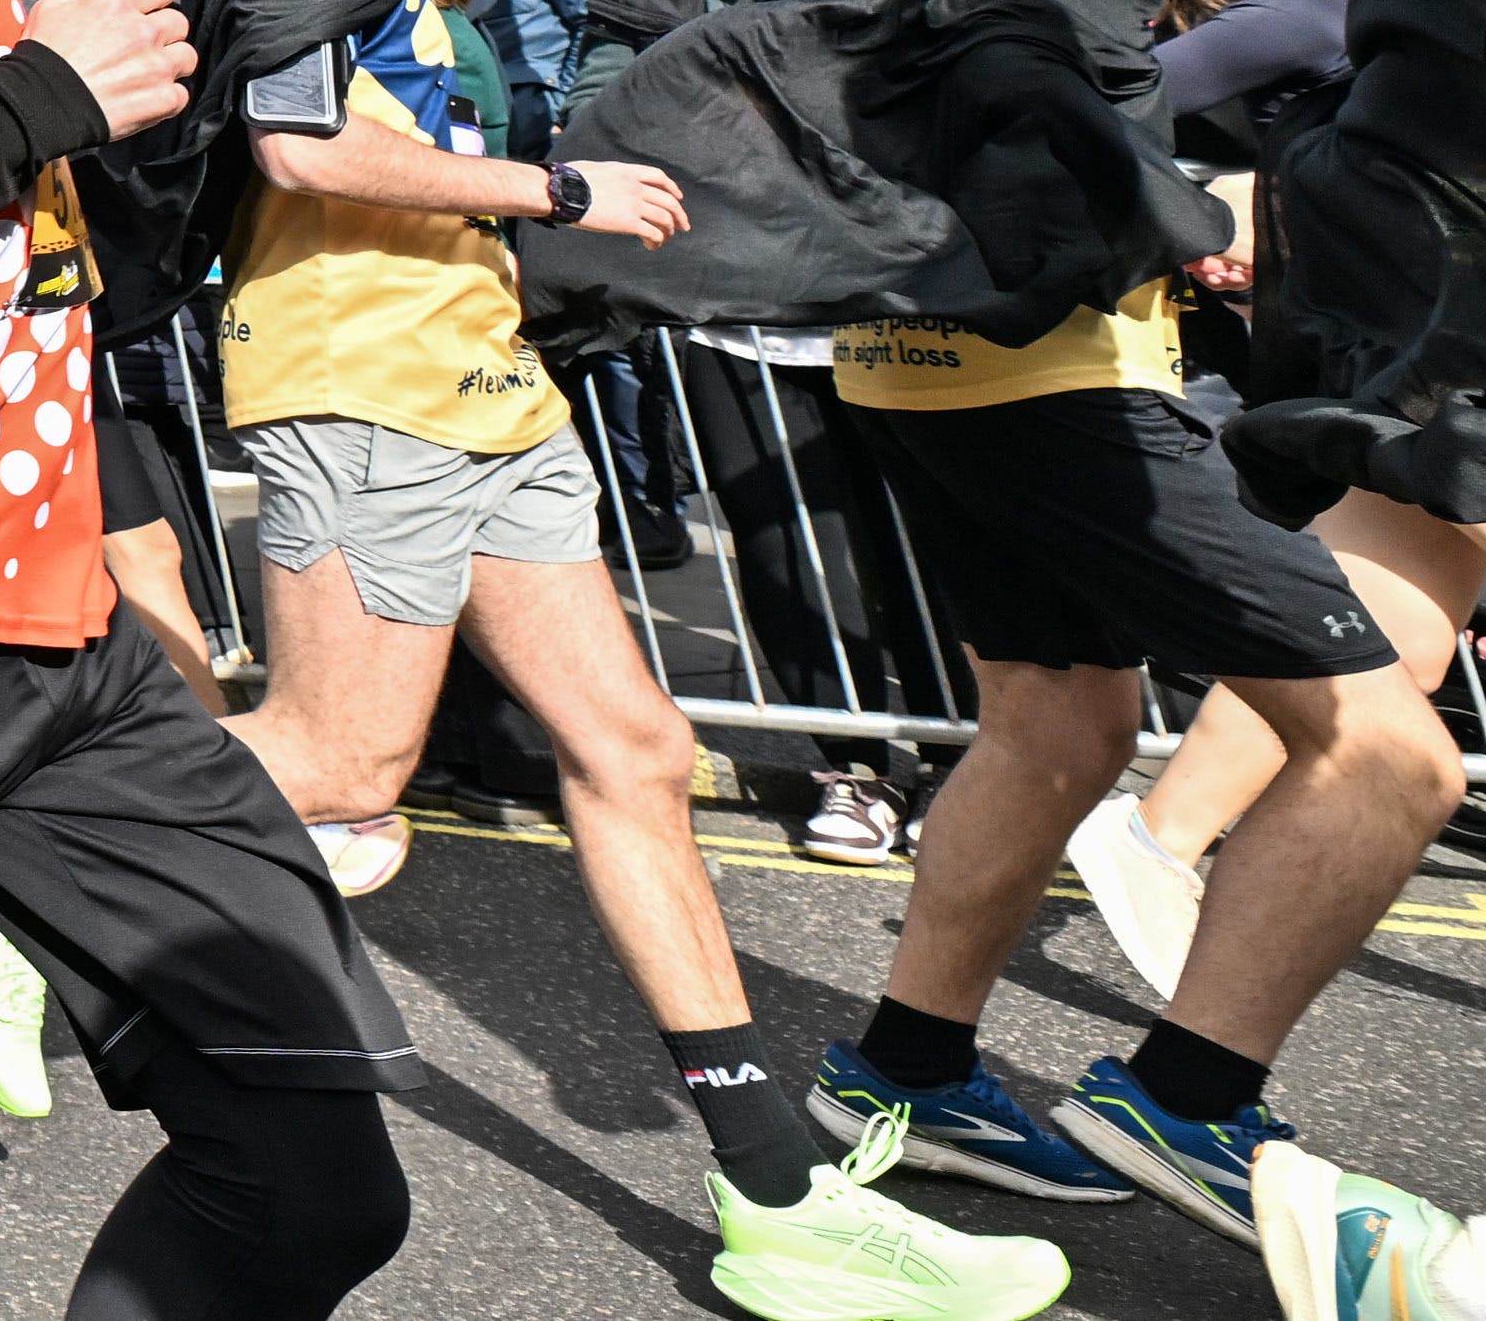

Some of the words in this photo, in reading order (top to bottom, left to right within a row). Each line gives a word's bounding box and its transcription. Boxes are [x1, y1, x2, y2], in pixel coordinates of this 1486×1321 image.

[854, 339, 893, 371] sight
[898, 339, 962, 369] loss
[682, 1061, 768, 1090] FILA
